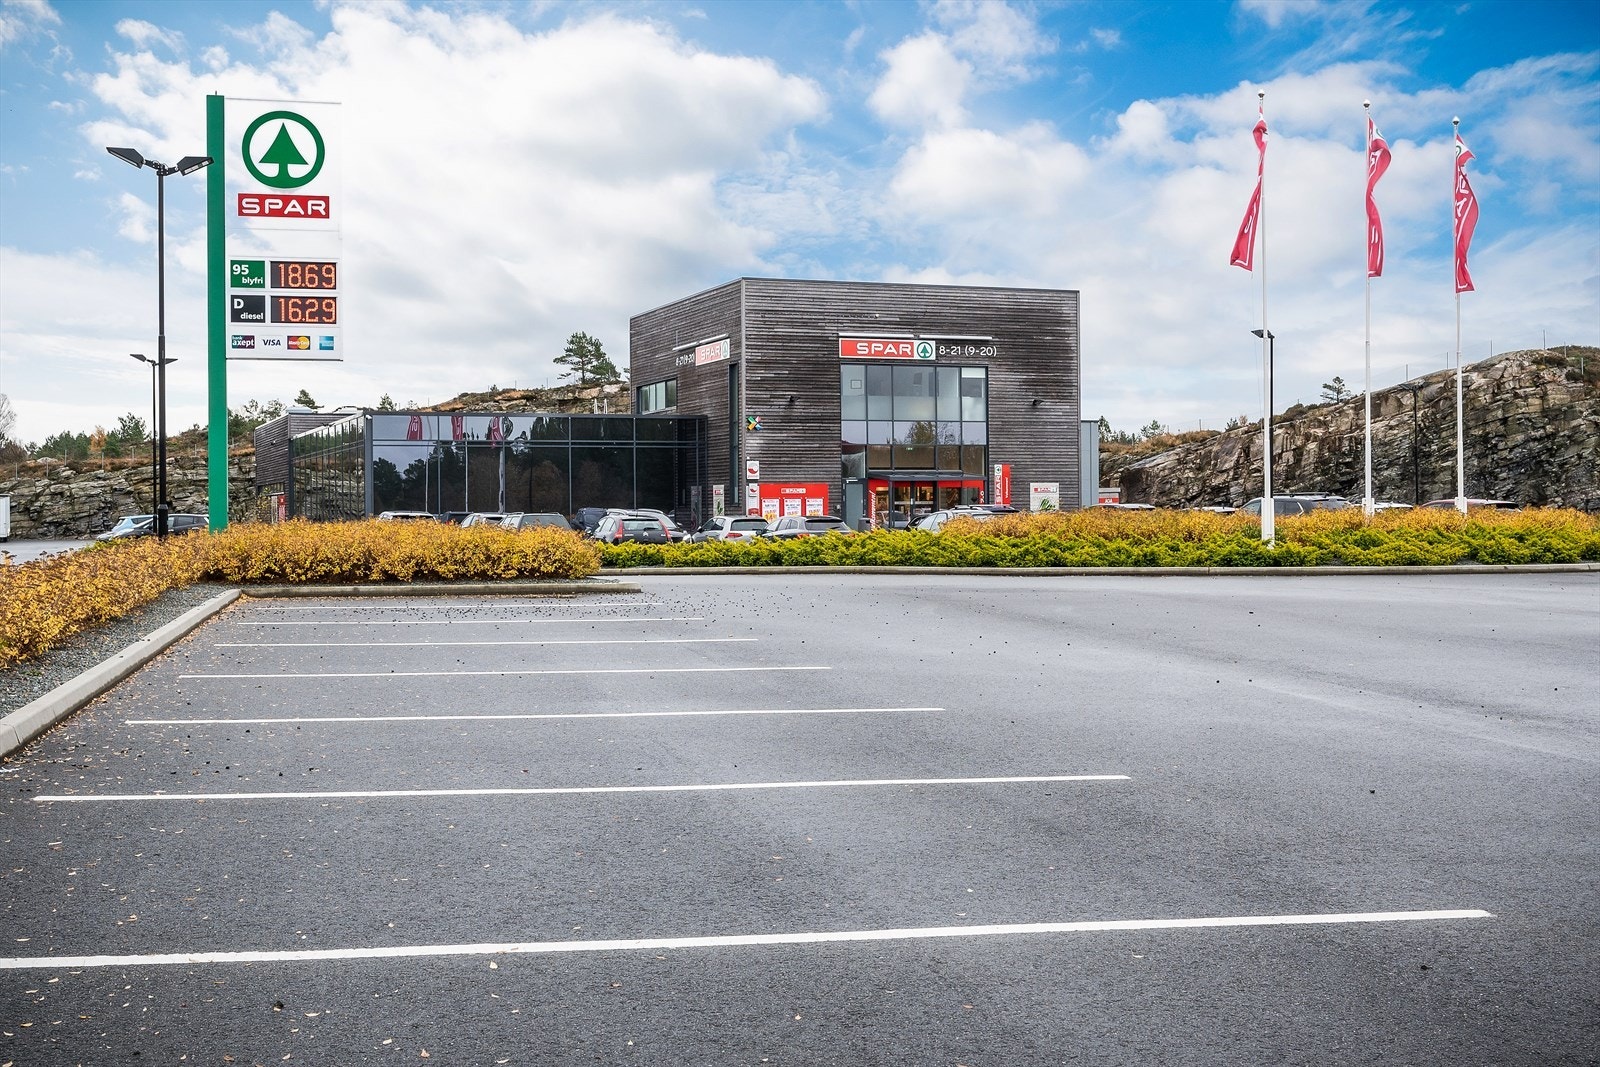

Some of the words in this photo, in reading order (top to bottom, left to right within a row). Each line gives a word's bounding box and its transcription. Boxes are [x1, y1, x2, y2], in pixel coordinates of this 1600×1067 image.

[241, 197, 326, 215] SPAR
[232, 264, 249, 275] 95
[278, 263, 335, 288] 18.69
[241, 276, 263, 285] blyfri
[233, 298, 244, 309] D
[240, 312, 264, 320] diesel
[278, 298, 335, 322] 16.29
[232, 338, 255, 347] axept
[857, 342, 912, 355] SPAR
[700, 345, 720, 361] SPAR
[938, 345, 961, 355] 8-21
[964, 346, 997, 357] (9-20)
